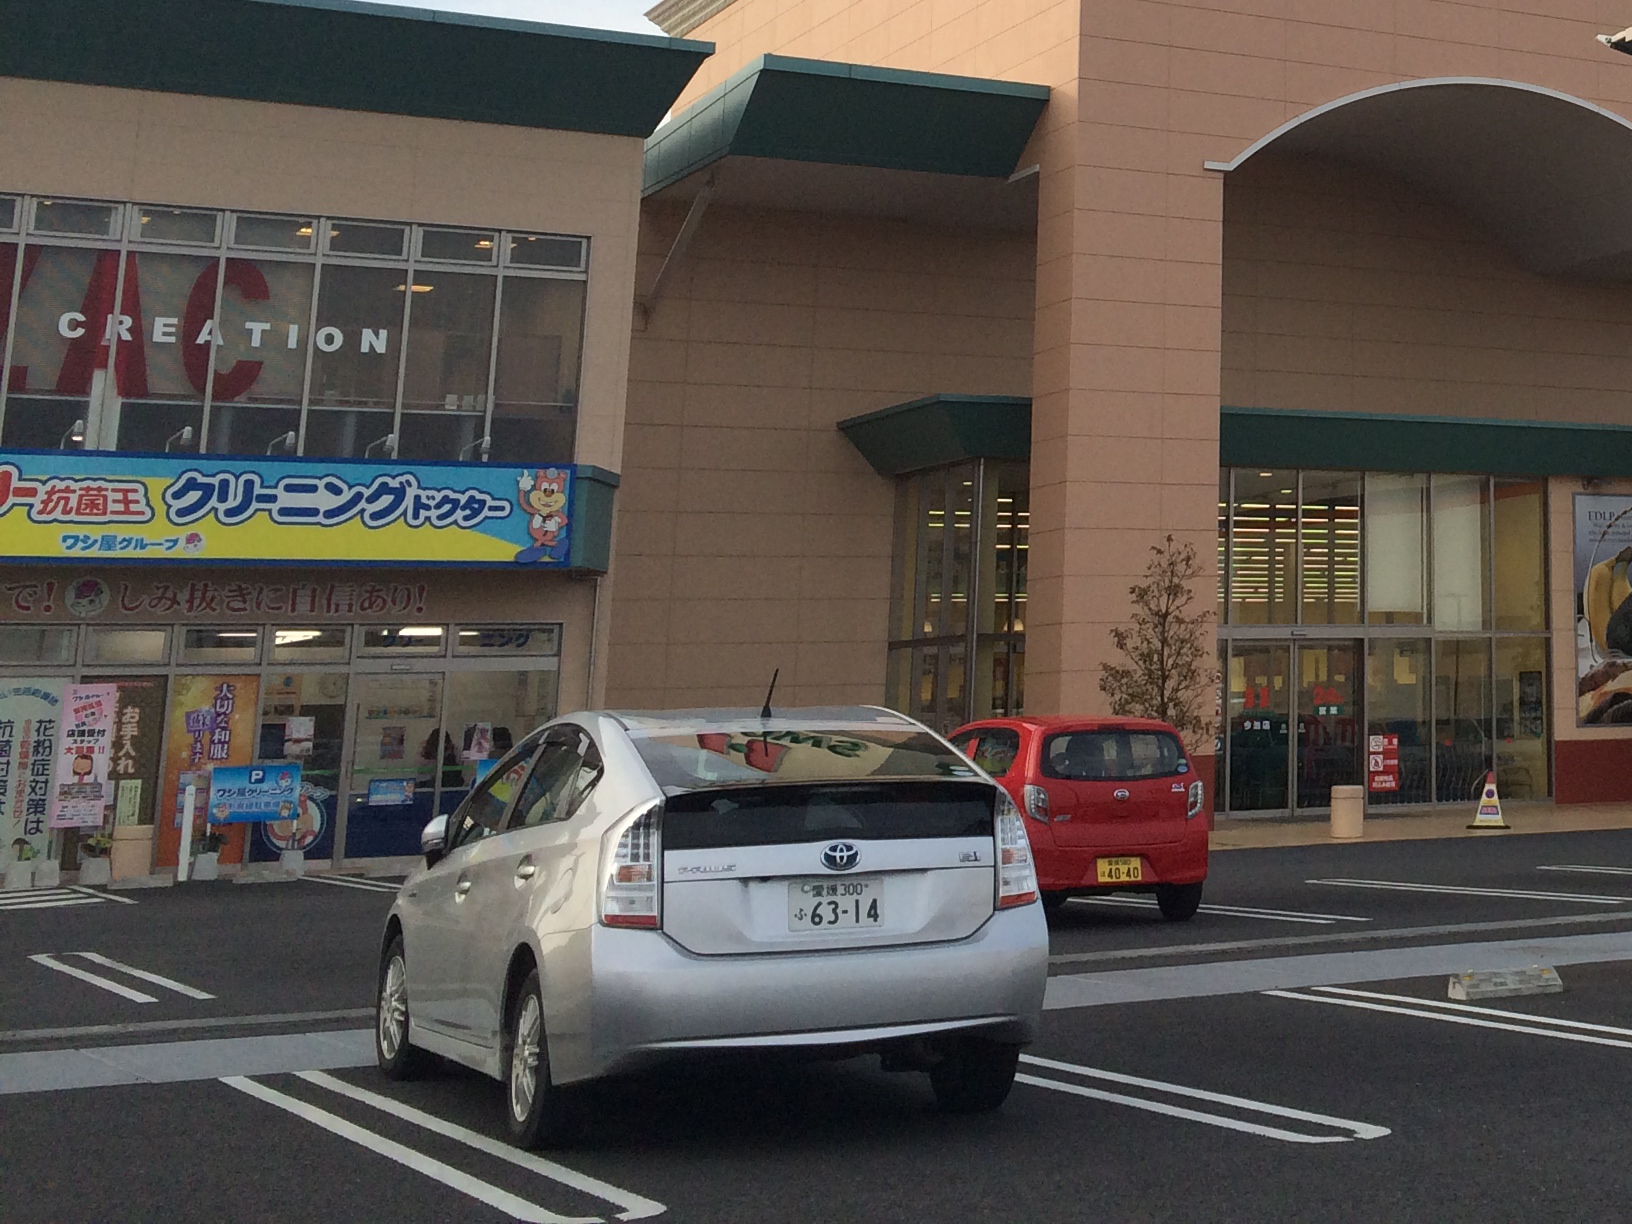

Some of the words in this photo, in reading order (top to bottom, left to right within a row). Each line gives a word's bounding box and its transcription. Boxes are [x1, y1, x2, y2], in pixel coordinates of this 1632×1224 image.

[57, 310, 389, 354] CREATION
[0, 469, 146, 518] ー抗菌王
[61, 533, 181, 552] ワシ屋グループ
[119, 580, 428, 615] しみ抜きに自信あり!
[210, 683, 236, 760] 大切な和服
[116, 705, 141, 774] お手入れ
[24, 719, 56, 836] 花粉症対策は
[216, 786, 294, 798] ワシ屋クリーニング
[250, 770, 264, 783] P
[1107, 867, 1140, 880] 40-40
[812, 882, 864, 898] 愛媛300
[794, 907, 808, 921] ふ
[810, 898, 880, 927] 63-14
